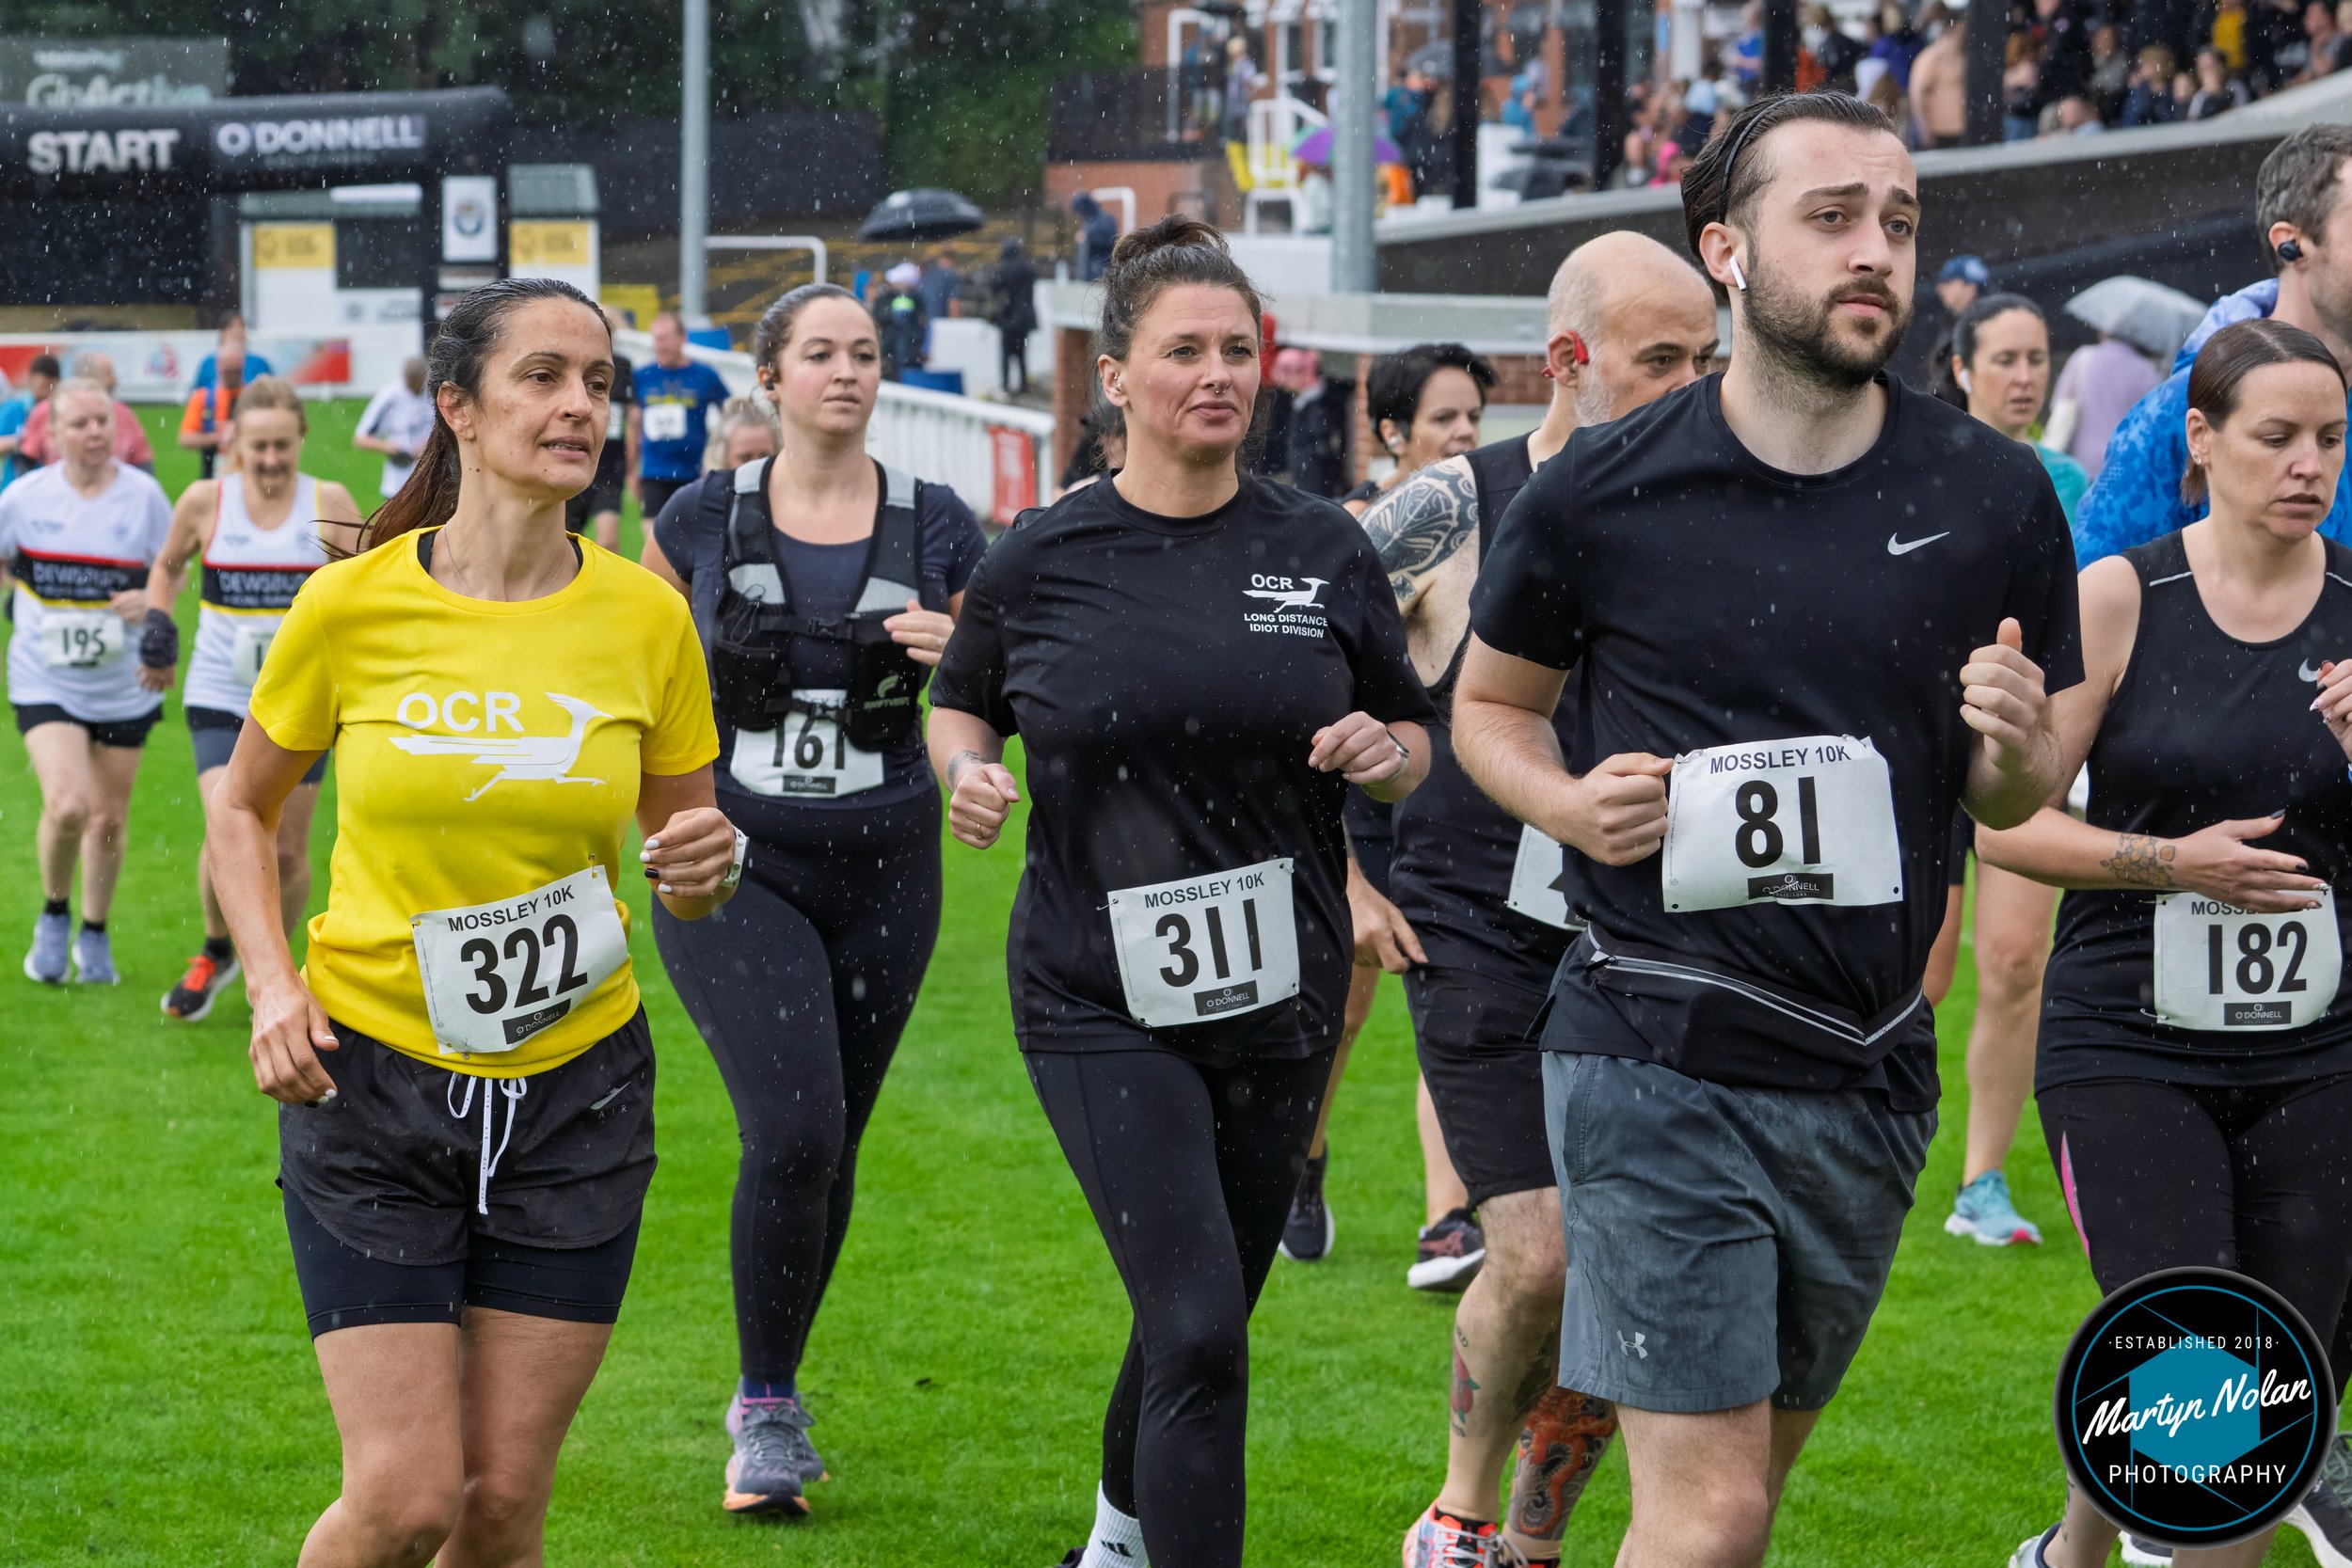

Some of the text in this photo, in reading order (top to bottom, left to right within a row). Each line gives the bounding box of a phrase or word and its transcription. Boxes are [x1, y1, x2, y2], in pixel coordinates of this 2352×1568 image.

[26, 128, 182, 175] START
[1250, 573, 1295, 590] OCR
[1244, 612, 1328, 627] LONG DISTANCE
[1249, 623, 1325, 639] IDIOT DIVISION
[396, 690, 525, 733] OCR
[772, 709, 846, 770] 161
[1710, 745, 1852, 774] MOSSLEY 10K
[1735, 776, 1821, 868] 81
[448, 884, 575, 932] MOSSLEY 10K
[1144, 872, 1265, 909] MOSSLEY 10K
[460, 913, 588, 1015] 322
[1155, 898, 1263, 988] 311
[2208, 921, 2308, 994] 182
[598, 1104, 628, 1119] AIR
